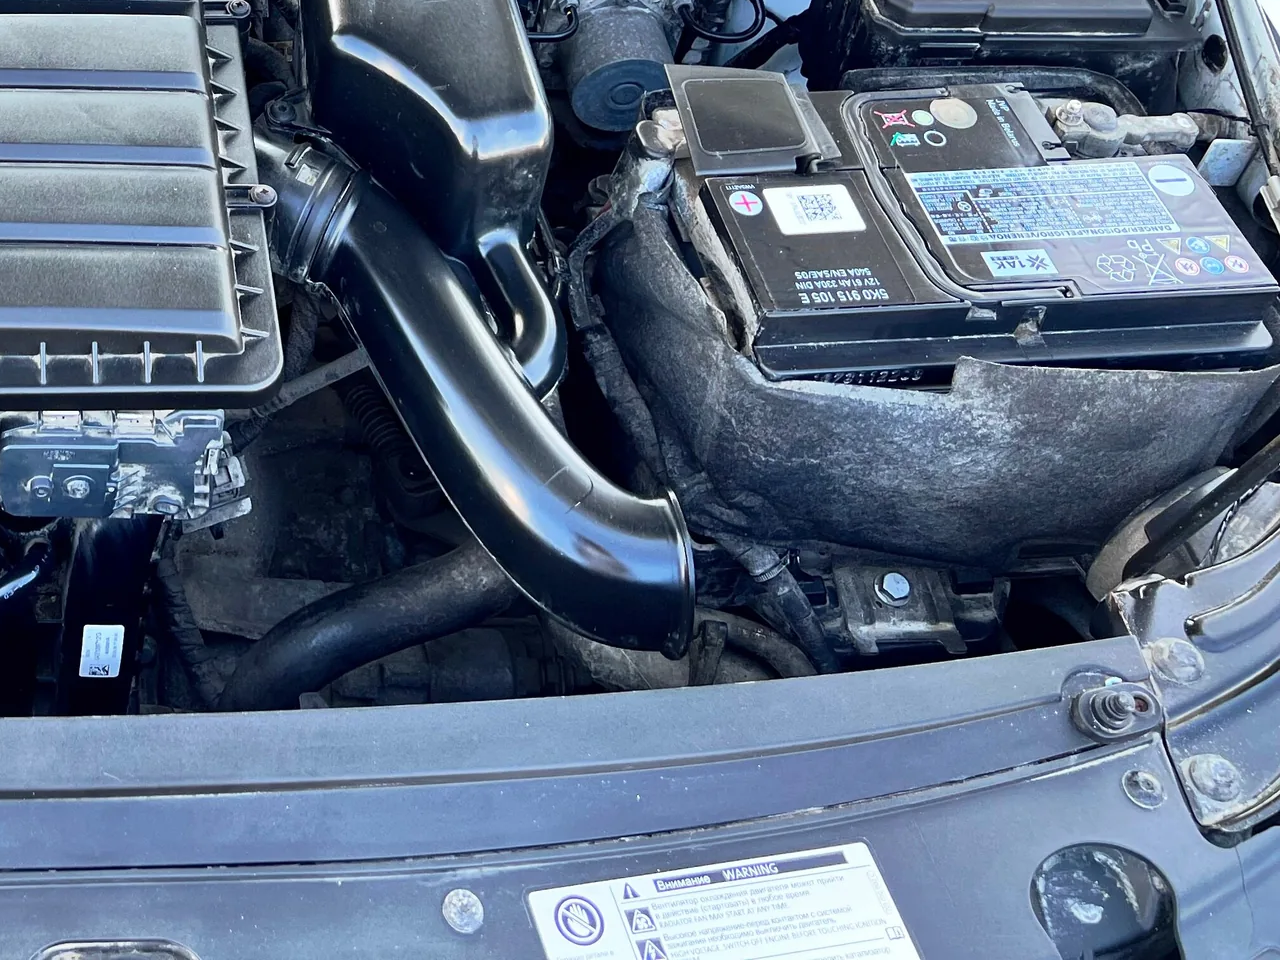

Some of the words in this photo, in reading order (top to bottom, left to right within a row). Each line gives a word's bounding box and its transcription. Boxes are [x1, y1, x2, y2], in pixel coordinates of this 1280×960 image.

[985, 99, 1001, 116] Made
[1001, 123, 1020, 147] Belarus
[996, 260, 1026, 270] 1AK
[847, 267, 872, 276] 540A
[795, 281, 814, 290] DIN
[814, 279, 838, 289] 330A
[838, 278, 863, 288] 61Ah
[864, 277, 881, 286] 12V
[798, 292, 811, 304] E
[811, 291, 835, 303] 105
[836, 289, 861, 302] 915
[863, 288, 889, 300] 5K0
[722, 863, 779, 881] WARNING
[656, 875, 711, 890] Внимание
[659, 917, 692, 929] RADIATOR
[694, 915, 707, 923] FAN
[709, 912, 723, 921] MAY
[725, 909, 744, 918] START
[756, 905, 769, 913] ANY
[818, 923, 853, 935] TOUCHING
